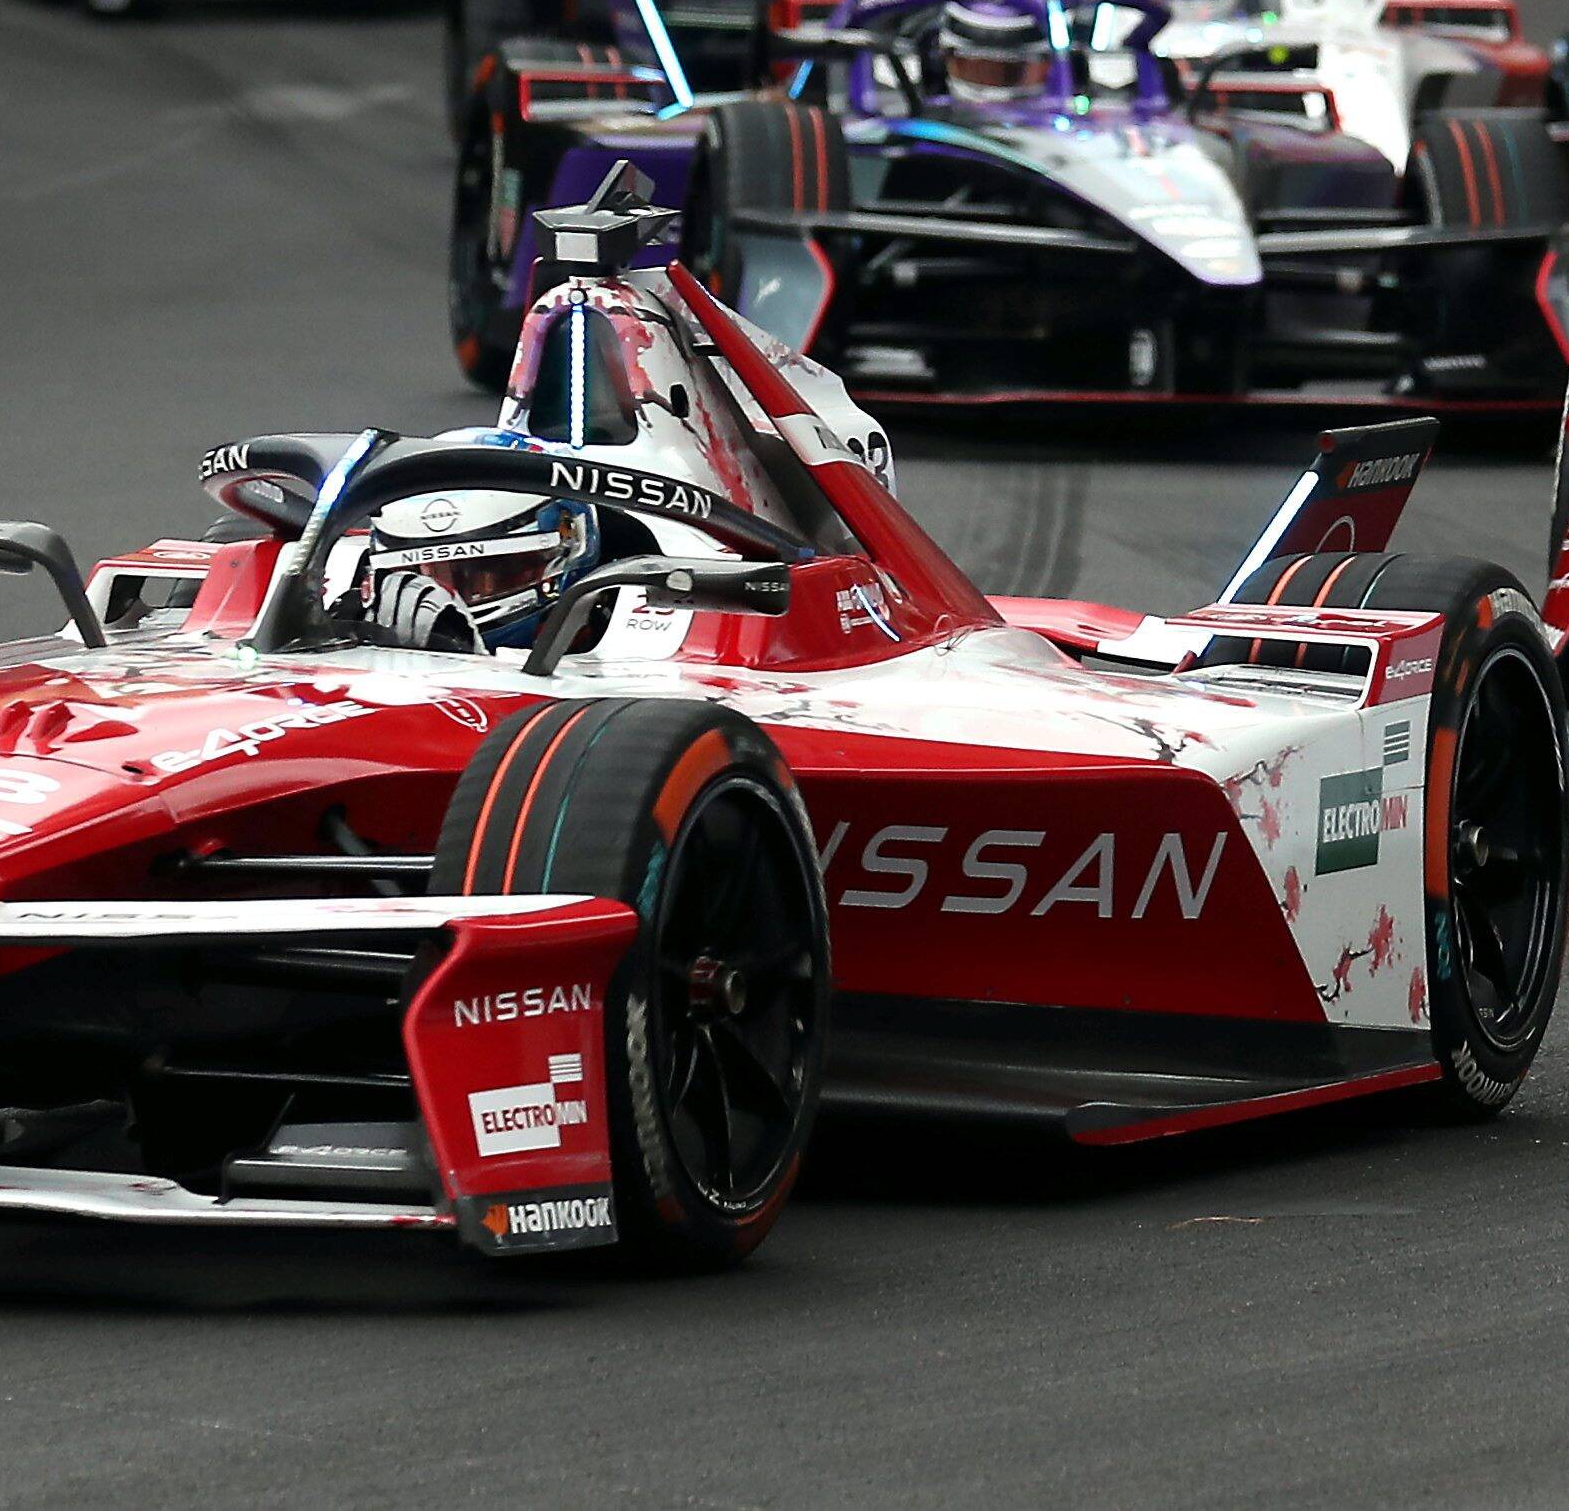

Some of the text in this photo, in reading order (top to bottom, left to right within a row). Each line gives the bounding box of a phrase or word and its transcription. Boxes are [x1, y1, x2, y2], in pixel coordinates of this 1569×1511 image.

[198, 443, 250, 481] SAN
[550, 462, 712, 519] NISSAN
[401, 544, 485, 564] NISSAN
[626, 619, 672, 631] ROW
[818, 821, 1228, 919] ISSAN
[453, 983, 592, 1028] NISSAN
